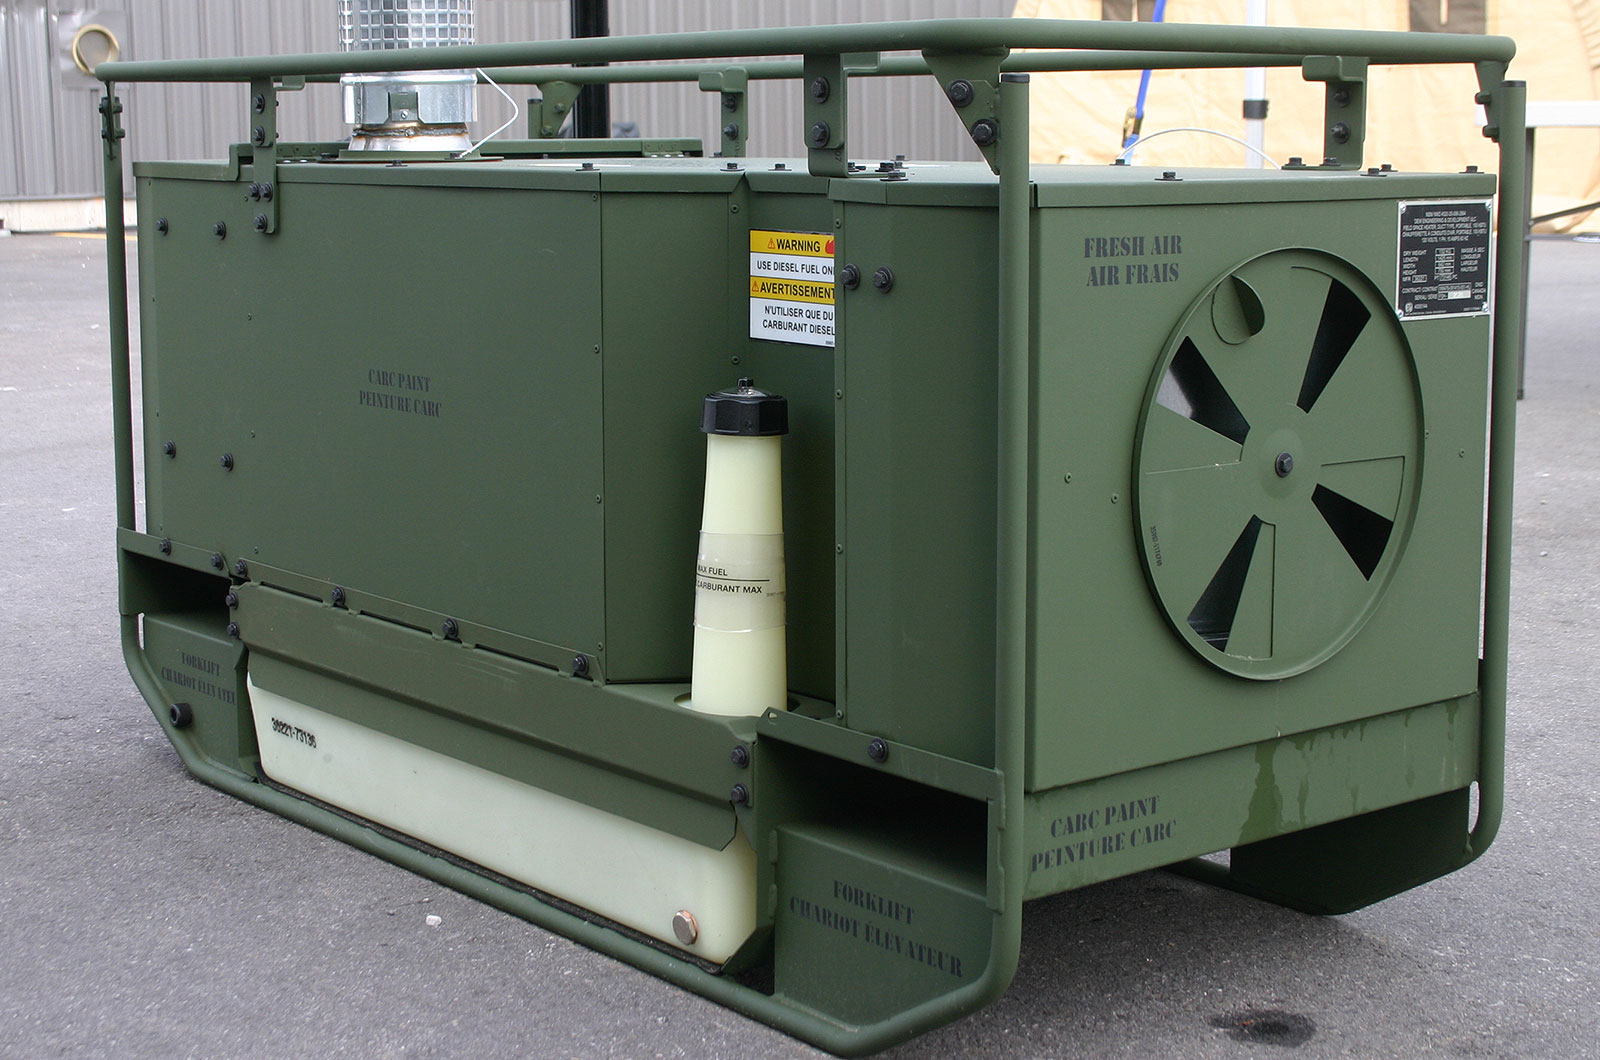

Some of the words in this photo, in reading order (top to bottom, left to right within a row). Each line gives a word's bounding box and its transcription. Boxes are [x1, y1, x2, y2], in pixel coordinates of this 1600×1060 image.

[777, 239, 820, 252] WARNING
[1084, 236, 1144, 258] FRESH
[1151, 235, 1183, 255] AIR
[757, 261, 772, 270] USE
[774, 262, 799, 272] DIESEL
[801, 264, 820, 274] FUEL
[1086, 265, 1119, 286] AIR
[1126, 263, 1179, 284] FRAIS
[760, 282, 835, 299] AVERTISSEMENT
[765, 305, 803, 318] N'UTILISER
[806, 309, 821, 320] QUE
[823, 311, 833, 320] DU
[763, 319, 807, 332] CARBURANT
[810, 324, 835, 336] DIESEL
[369, 369, 395, 387] CARC
[398, 373, 430, 392] PAINT
[360, 390, 411, 413] PEINTURE
[414, 400, 442, 417] CARC
[708, 567, 728, 576] FUEL
[182, 652, 219, 676] FORKLIFT
[162, 667, 195, 690] CHARIOT
[1051, 810, 1099, 838] CARC
[1105, 795, 1160, 826] PAINT
[1032, 832, 1126, 872] PEINTURE
[1130, 820, 1176, 847] CARC
[833, 880, 915, 925] FORKLIFT
[790, 896, 861, 938] CHARIOT
